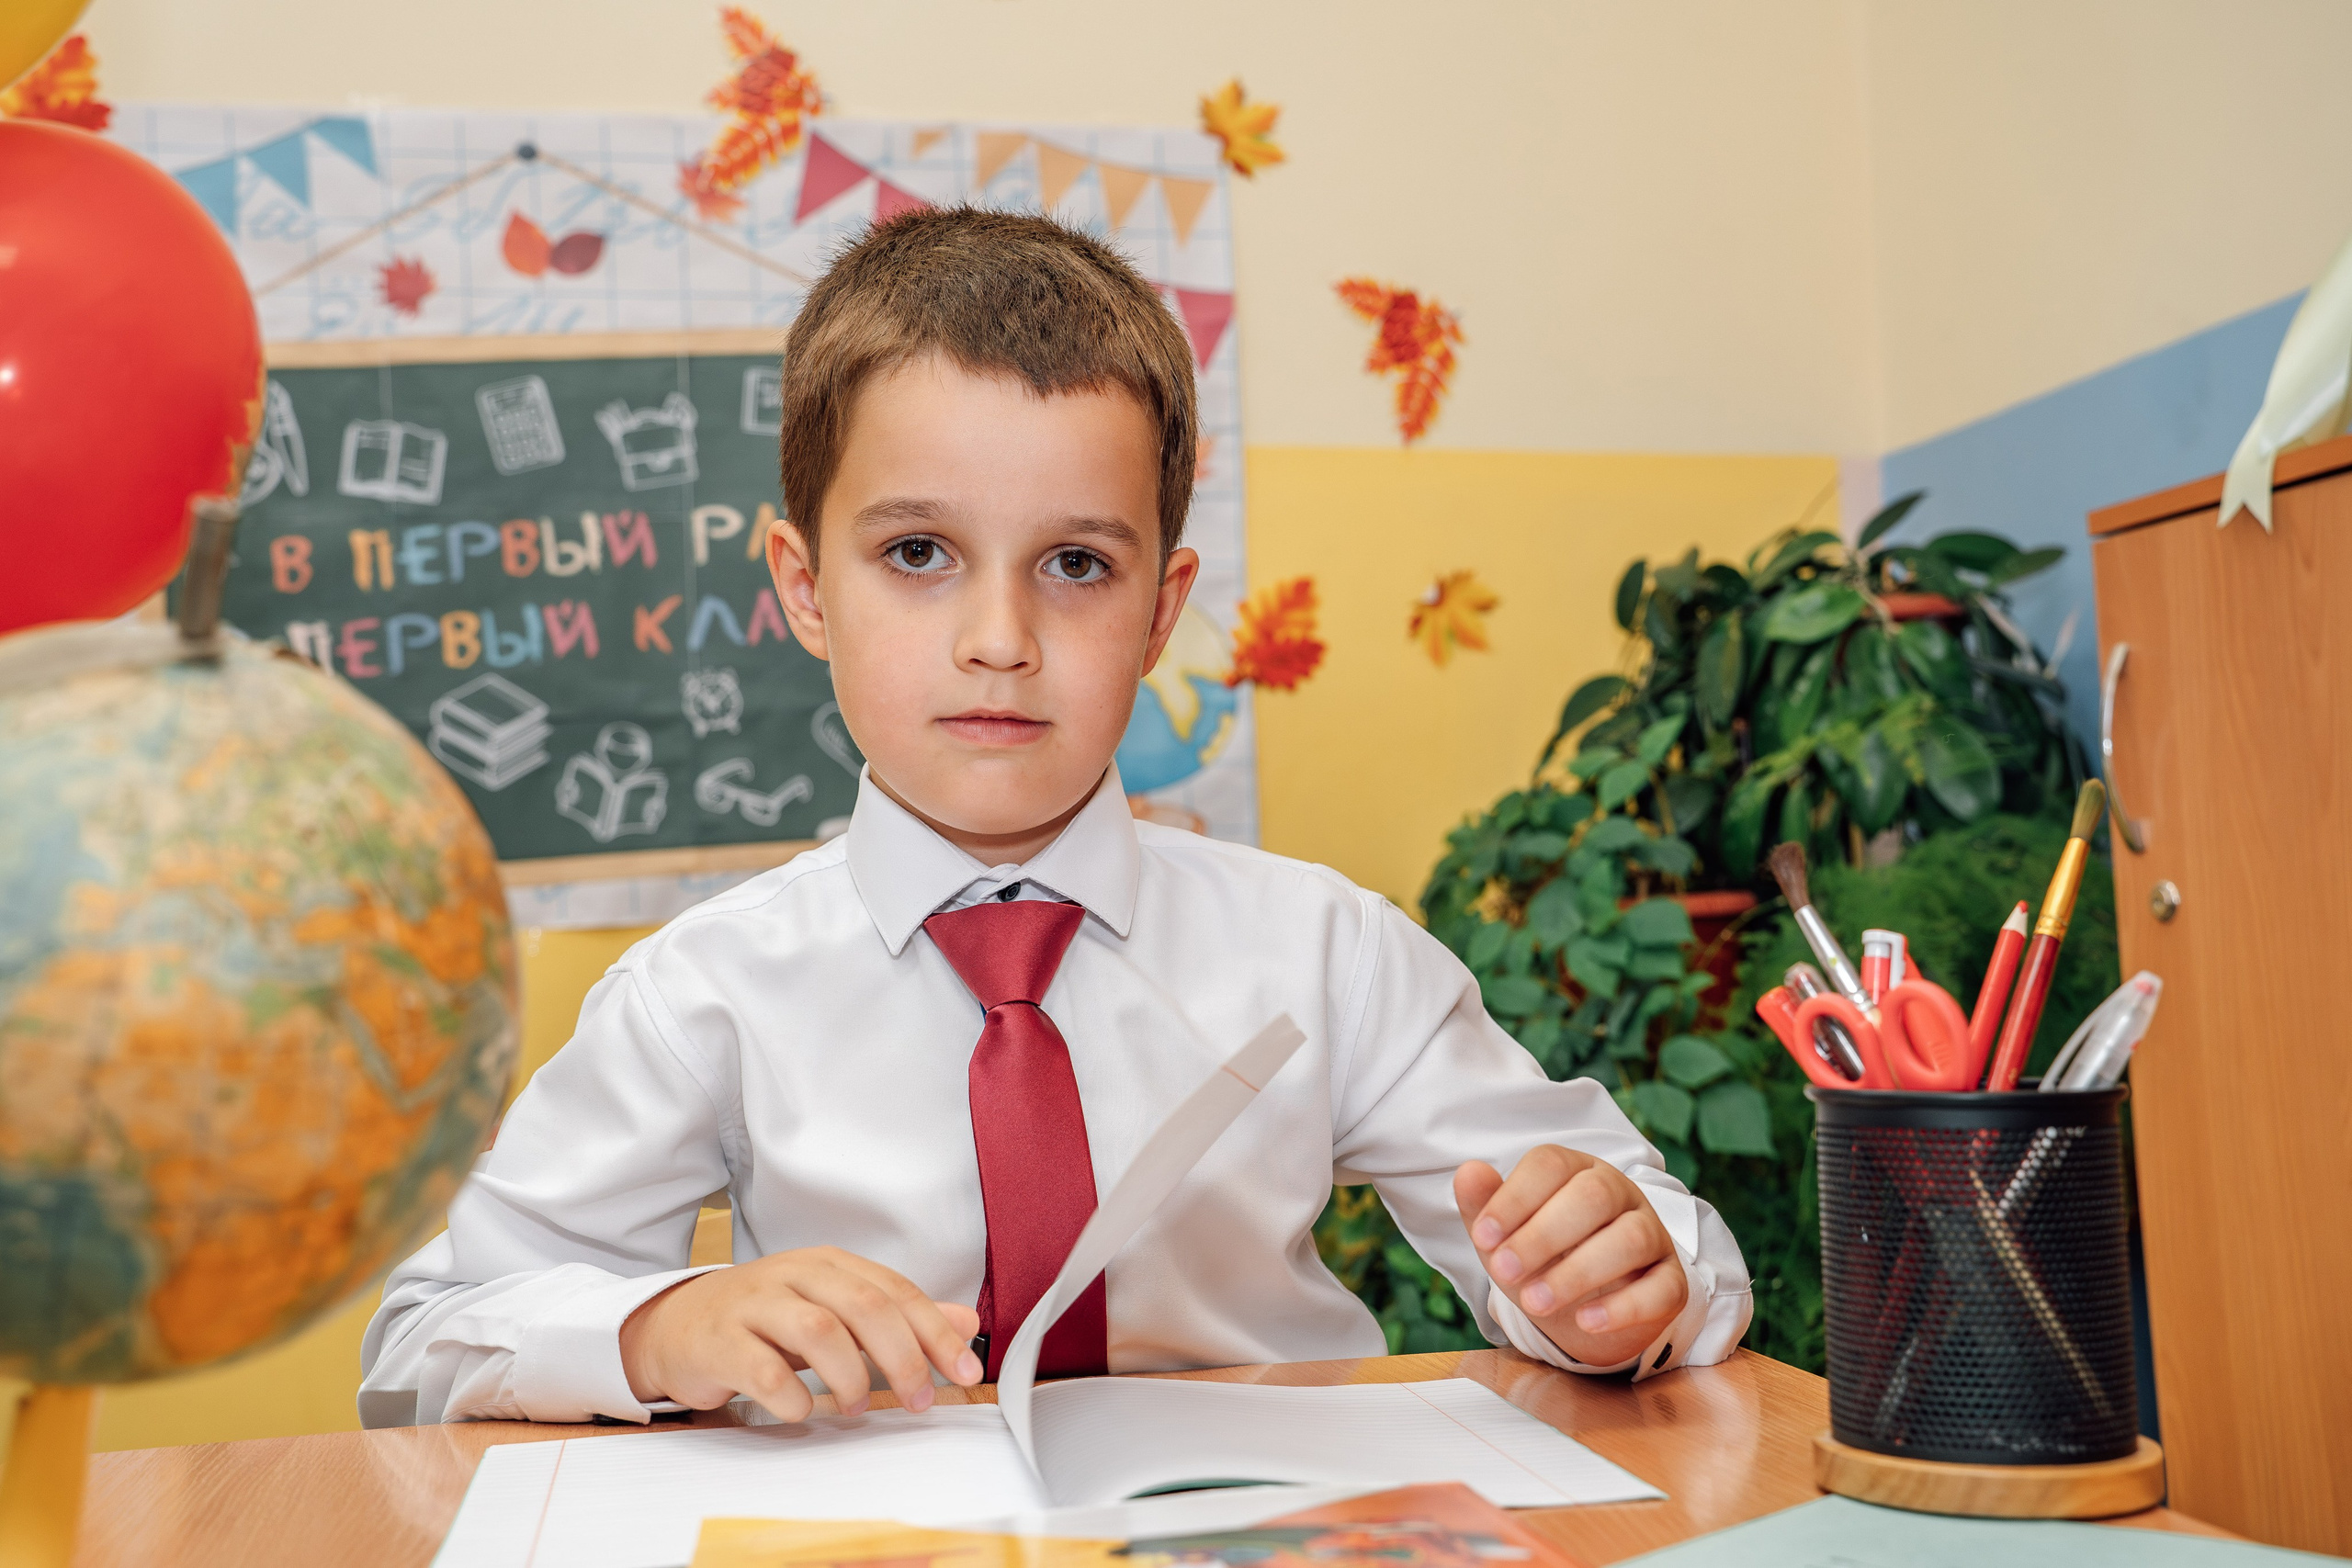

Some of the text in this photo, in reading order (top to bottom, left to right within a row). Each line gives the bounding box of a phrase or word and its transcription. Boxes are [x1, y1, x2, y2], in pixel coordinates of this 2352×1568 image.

[269, 535, 314, 594] В
[348, 509, 659, 592] ПЕРВЫЙ
[286, 588, 788, 680] ПЕРВЫЙ КЛА
